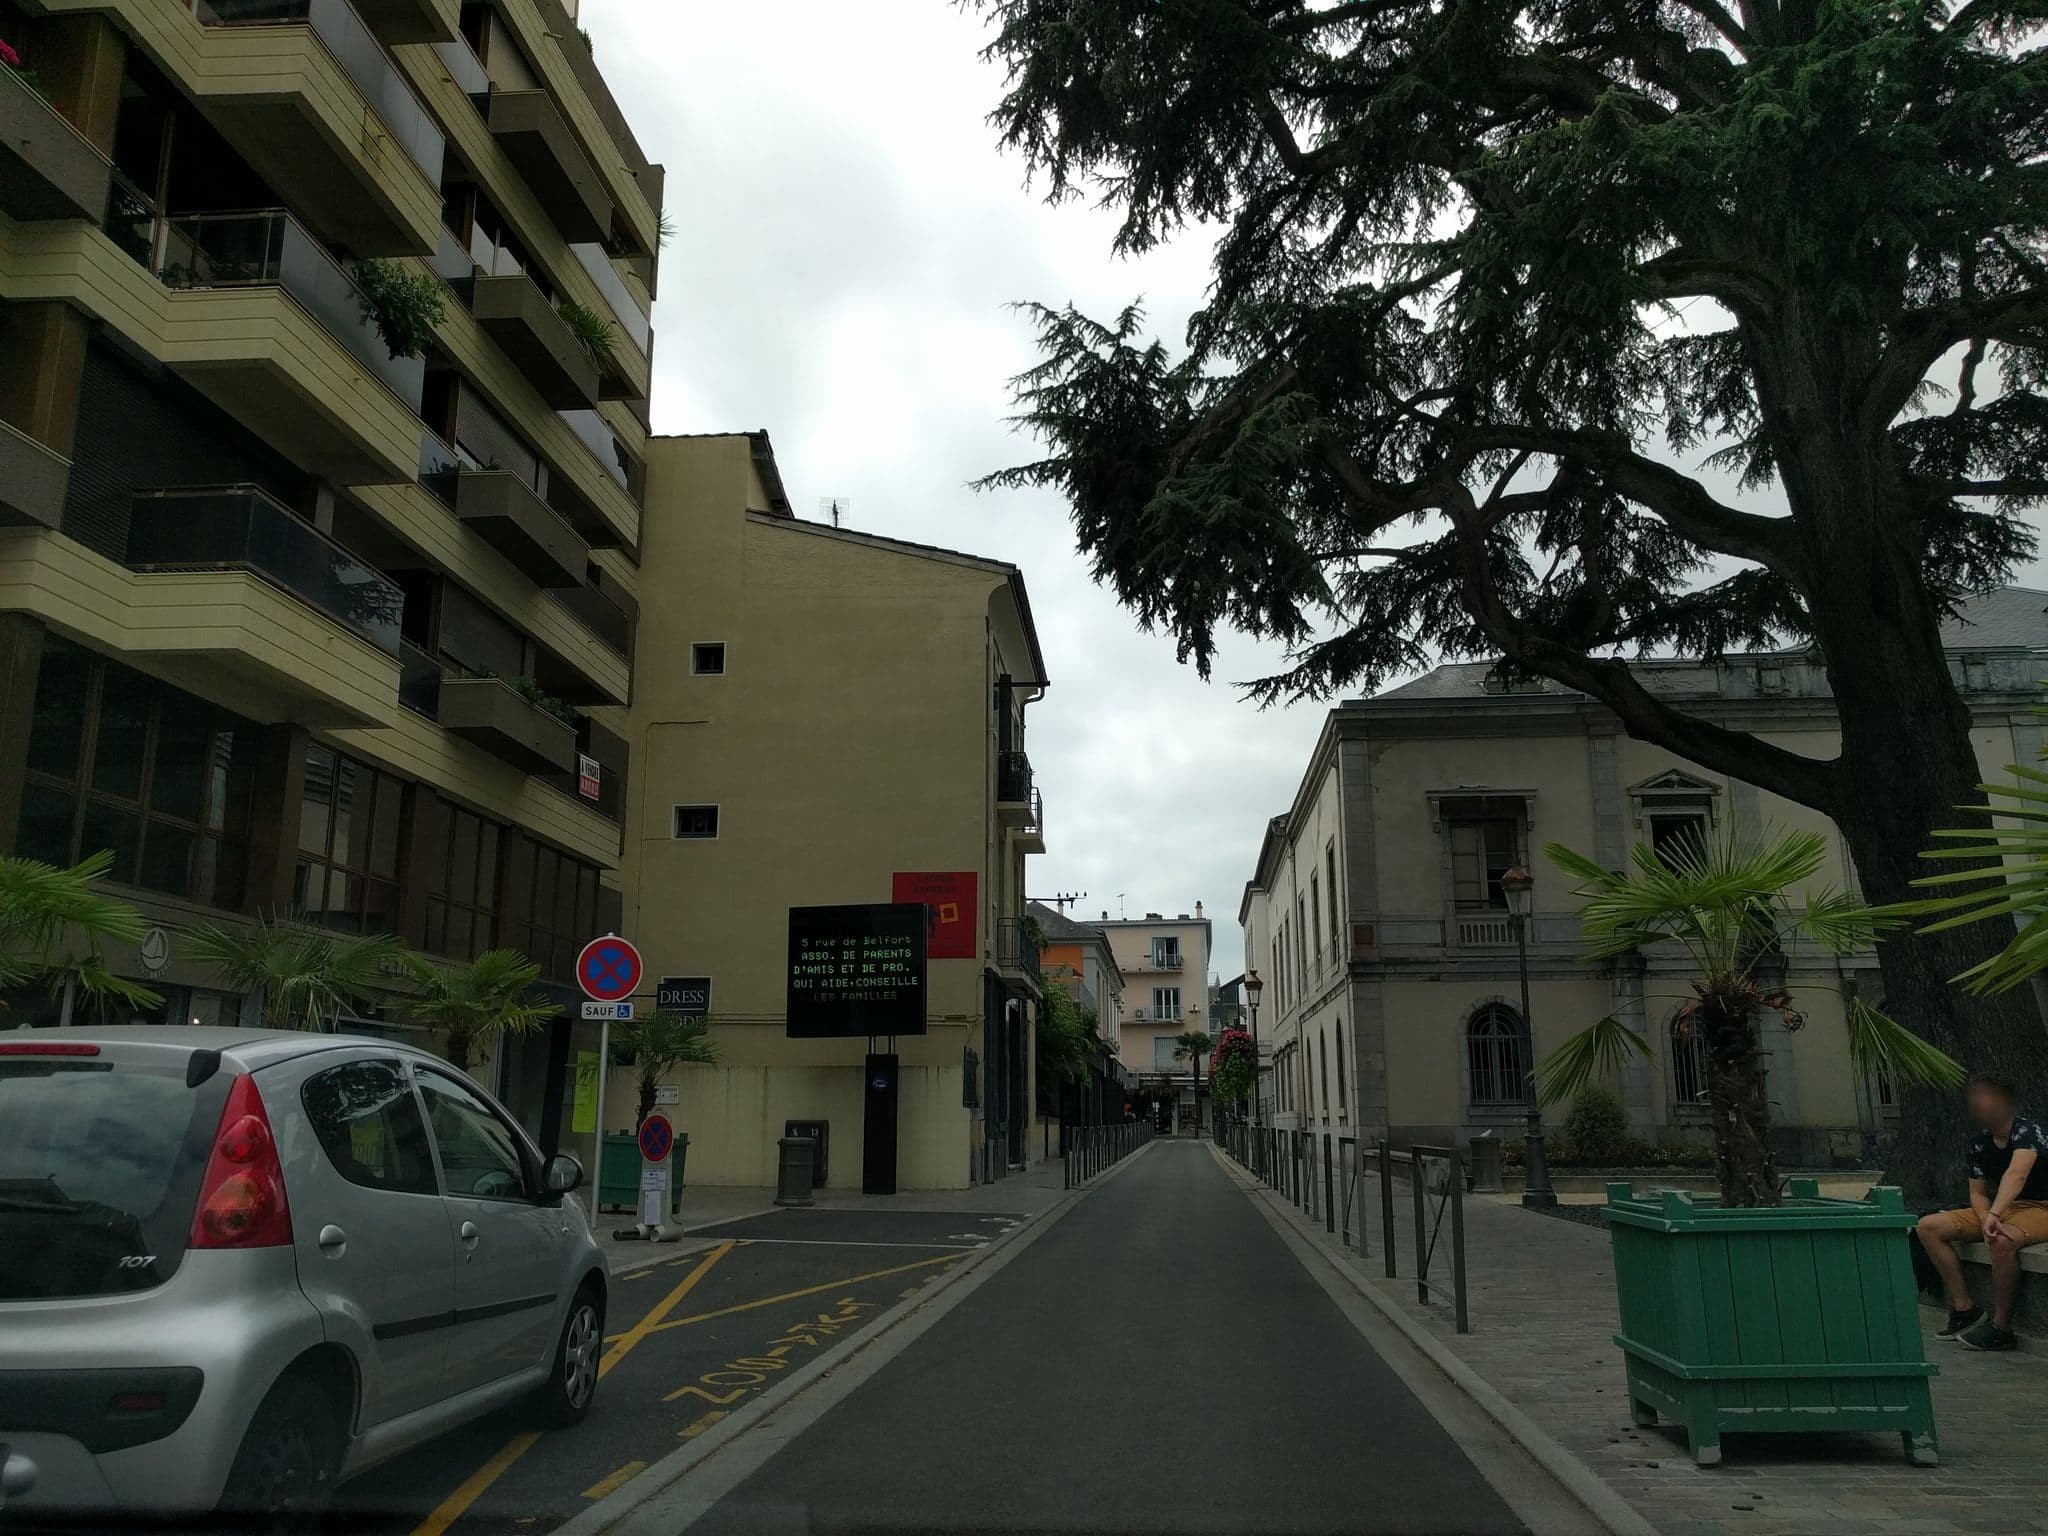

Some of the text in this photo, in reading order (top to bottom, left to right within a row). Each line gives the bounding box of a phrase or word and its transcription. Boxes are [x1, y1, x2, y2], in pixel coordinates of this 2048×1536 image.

[801, 935, 912, 947] 5 rue de Belfort
[801, 948, 912, 961] ASSO. DE PARENTS
[793, 963, 910, 975] D'AMIS ET DE PRO.
[793, 979, 814, 989] QUI
[660, 989, 704, 1004] DRESS
[814, 990, 897, 1001] LES FAMILLES
[585, 1006, 614, 1016] SAUF
[119, 1255, 157, 1268] 107
